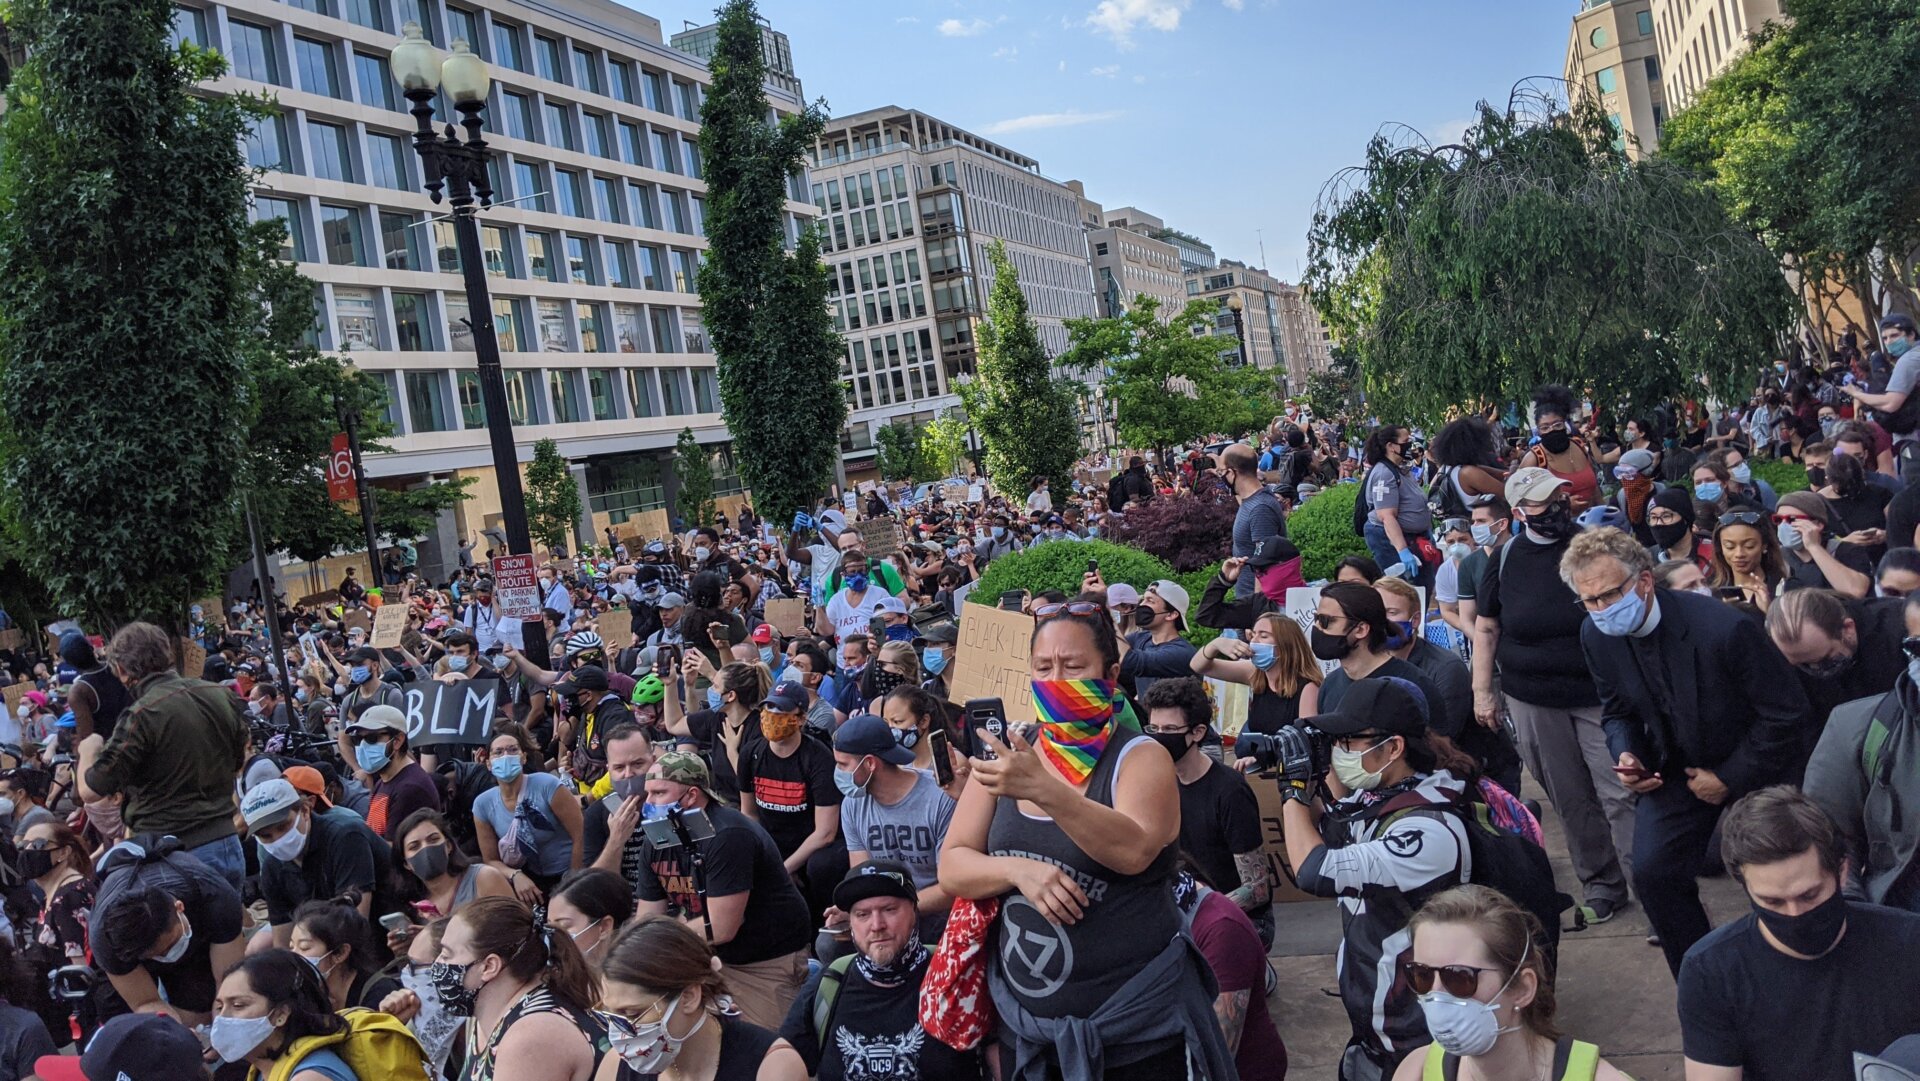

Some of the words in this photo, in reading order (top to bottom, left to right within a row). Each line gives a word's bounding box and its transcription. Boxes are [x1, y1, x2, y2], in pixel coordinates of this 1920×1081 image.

[329, 451, 351, 479] 16
[500, 558, 526, 570] SNOW
[496, 567, 533, 578] EMERGENCY
[501, 576, 533, 588] ROUTE
[500, 589, 509, 598] NO
[510, 587, 536, 596] PARKING
[507, 597, 531, 607] DURING
[502, 605, 538, 616] EMERGENCY
[852, 624, 870, 636] AID
[964, 617, 1005, 654] BLACK
[406, 685, 495, 739] BLM
[756, 797, 808, 812] IMMIGRANT
[869, 825, 931, 851] 2020
